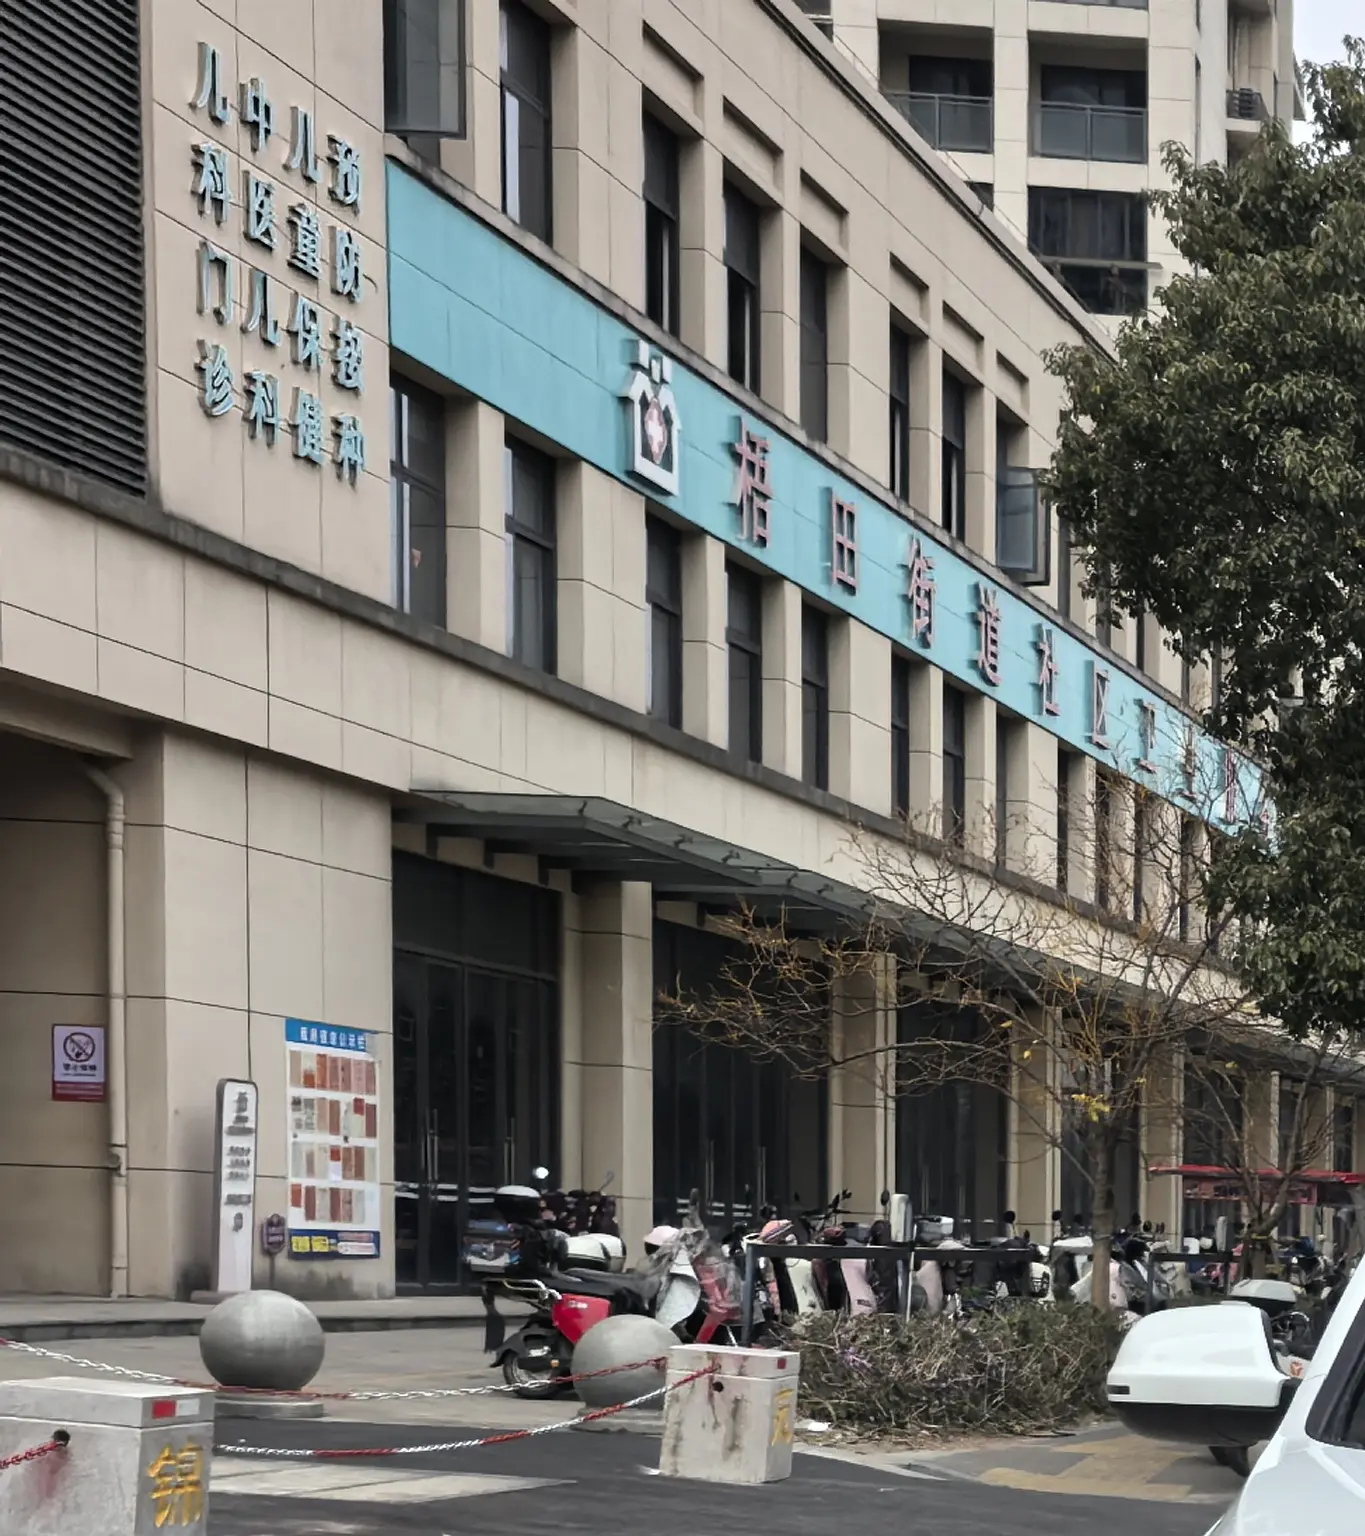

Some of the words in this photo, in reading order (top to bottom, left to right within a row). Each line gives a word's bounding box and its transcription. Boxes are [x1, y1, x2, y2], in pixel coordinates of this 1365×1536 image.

[191, 41, 235, 417] 儿科门诊
[240, 77, 281, 447] 中医儿科
[284, 105, 325, 466] 儿童保健
